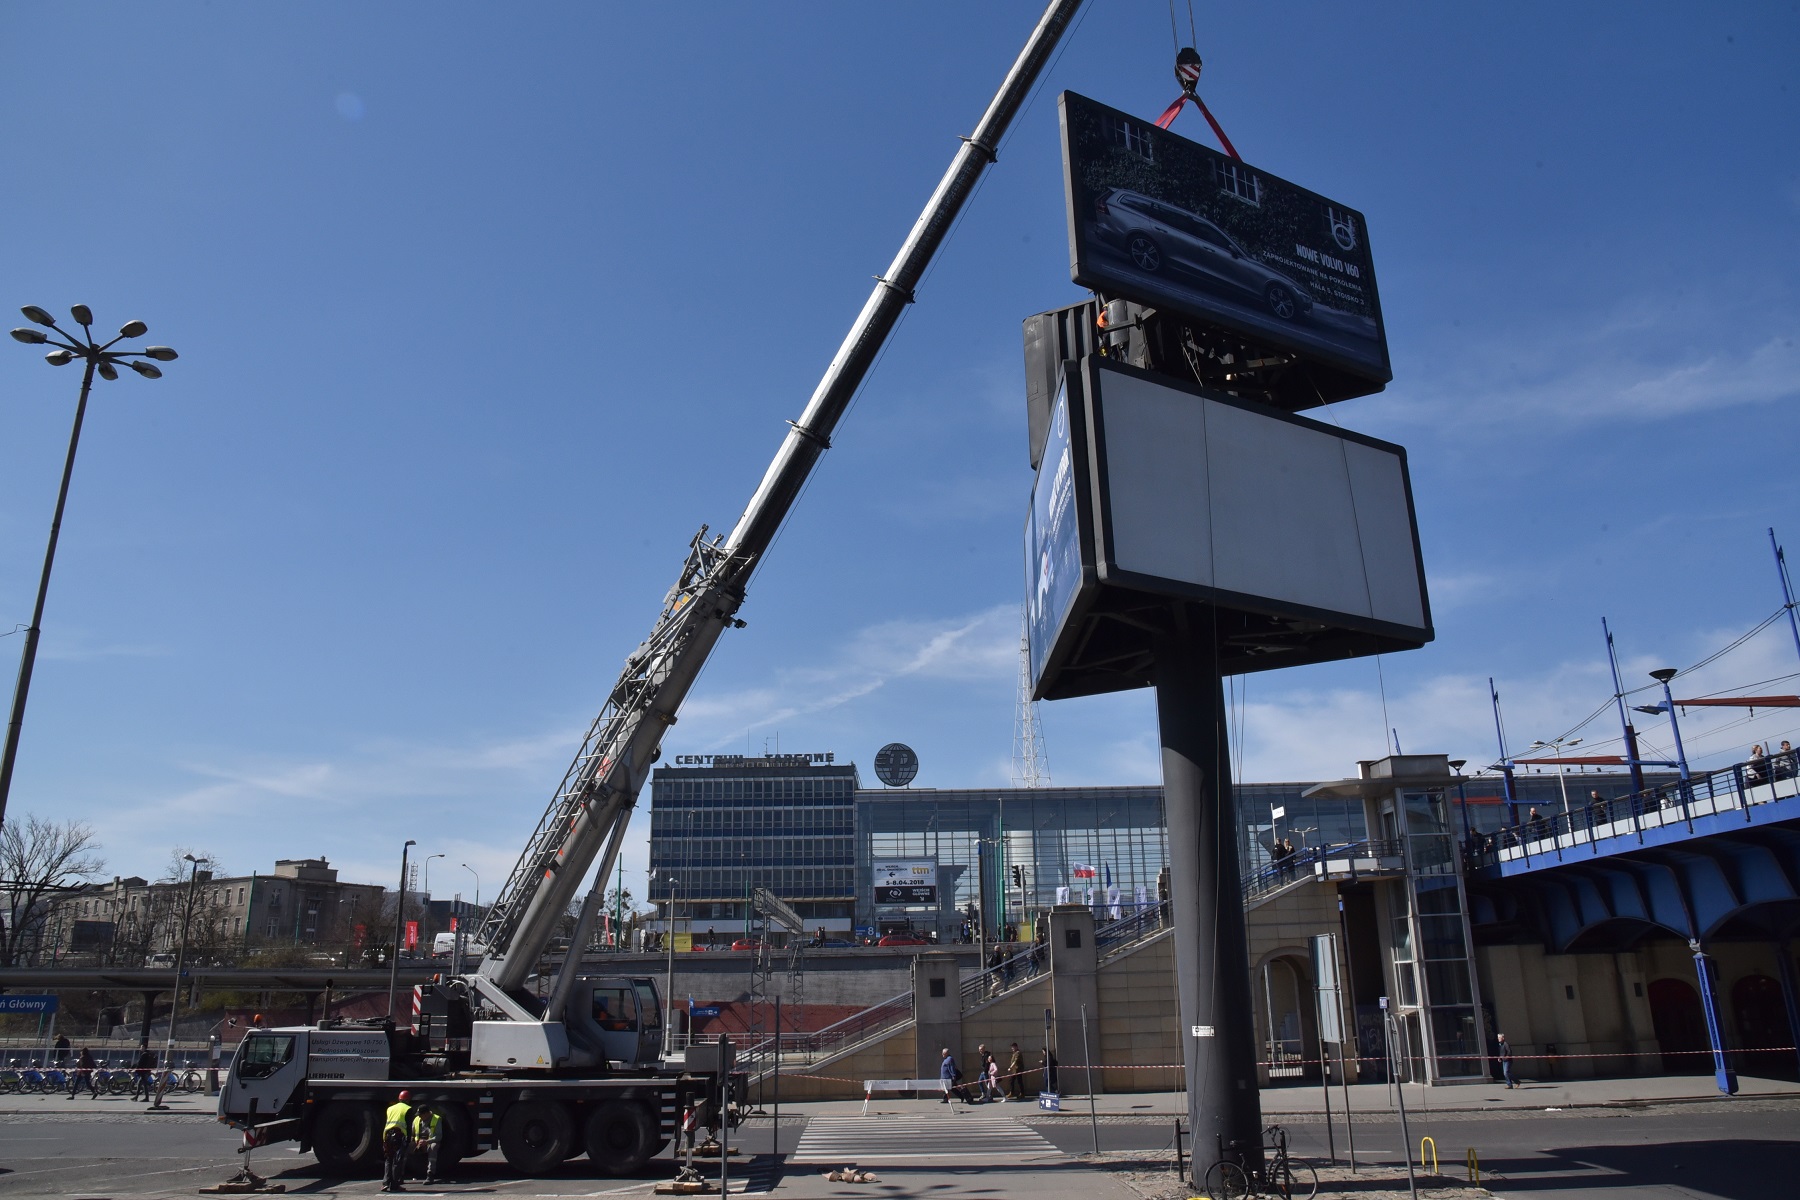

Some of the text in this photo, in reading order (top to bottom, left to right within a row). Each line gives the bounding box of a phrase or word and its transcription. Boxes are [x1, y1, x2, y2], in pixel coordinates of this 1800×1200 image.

[1296, 243, 1360, 278] NOWE VOLVO V60
[1262, 250, 1362, 291] ZAPROJEKTOWANE NA POKOLENIA
[675, 754, 743, 764] CENTRUM
[867, 927, 874, 936] 8
[9, 1000, 47, 1011] Główny
